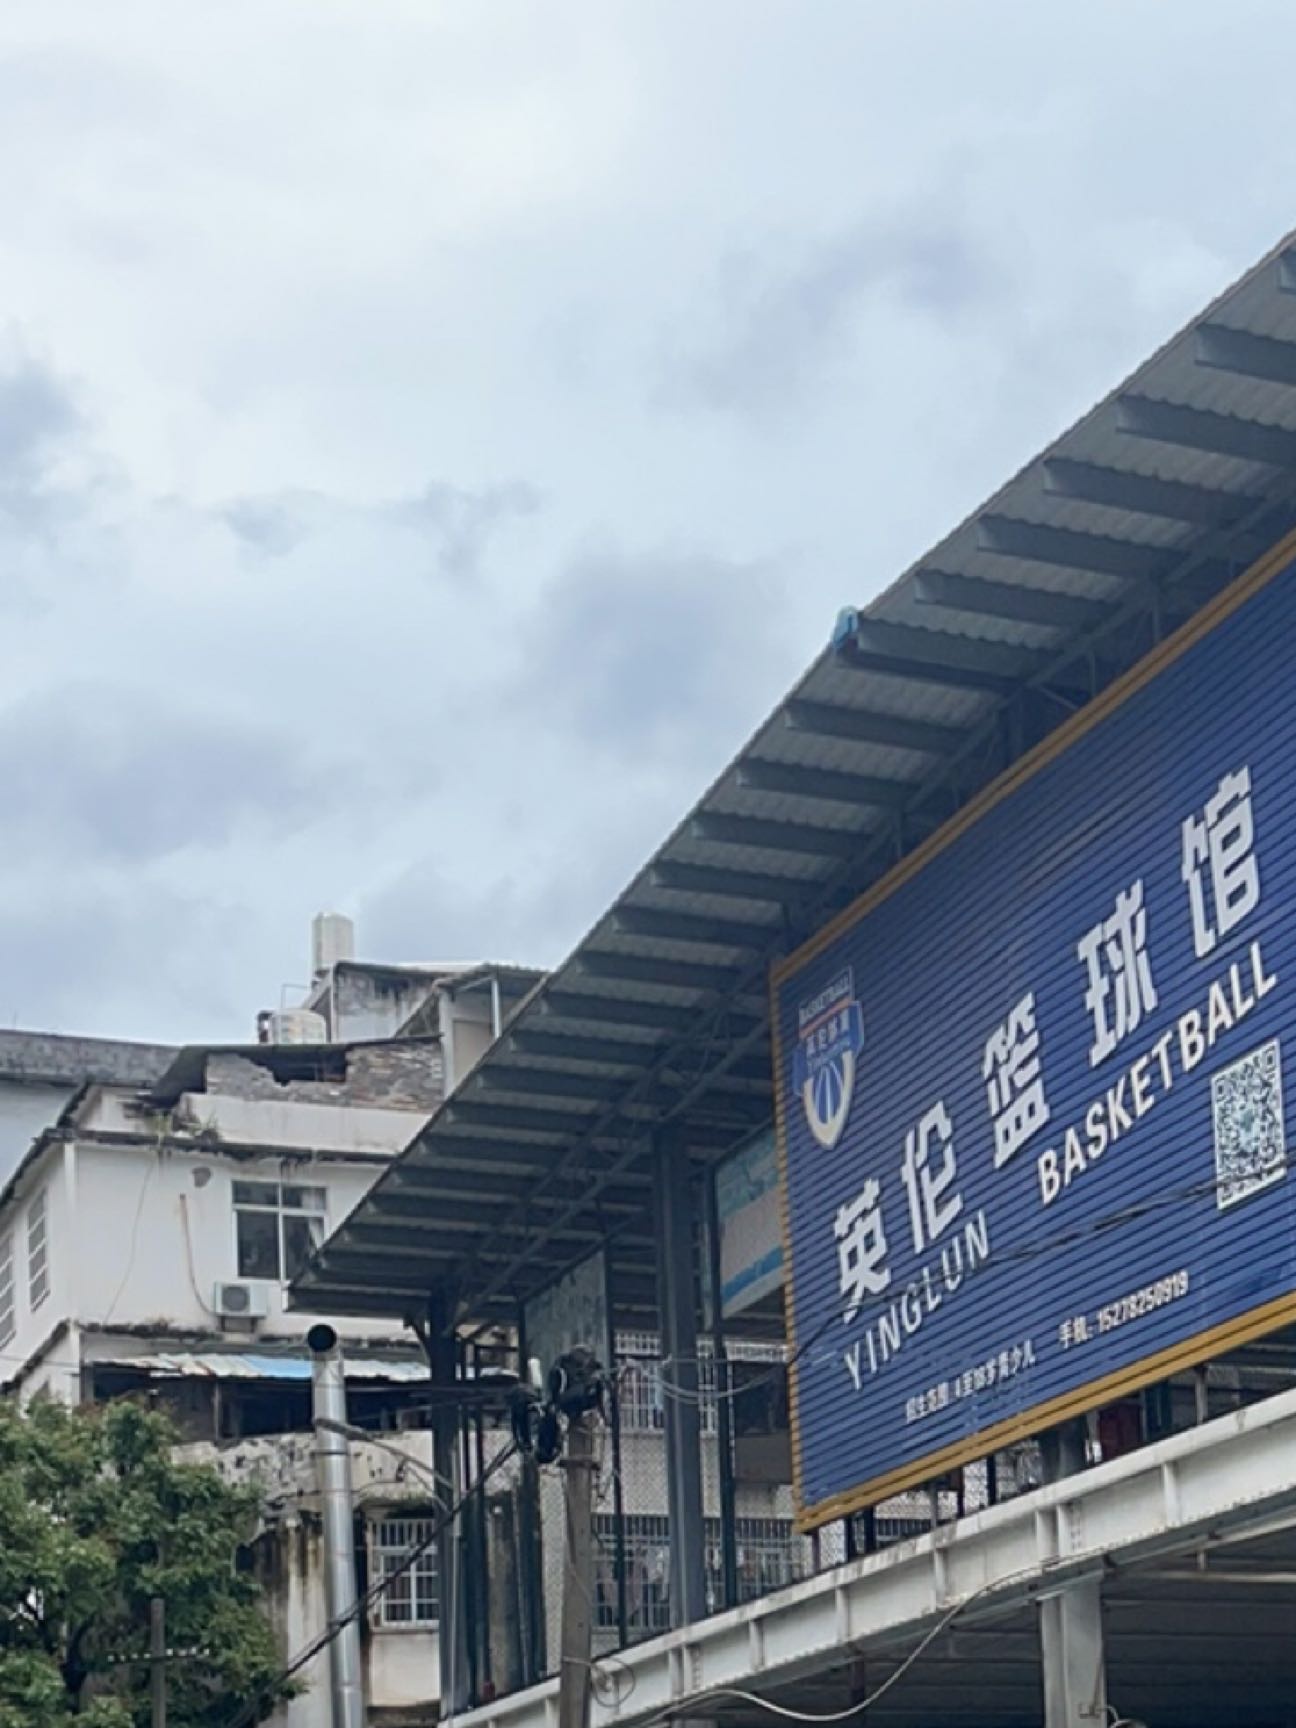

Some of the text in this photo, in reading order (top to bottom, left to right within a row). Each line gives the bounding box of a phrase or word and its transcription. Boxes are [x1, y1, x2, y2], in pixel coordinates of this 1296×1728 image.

[833, 764, 1261, 1325] 英伦篮球馆
[843, 940, 1278, 1392] YINGLUN BASKETBALL
